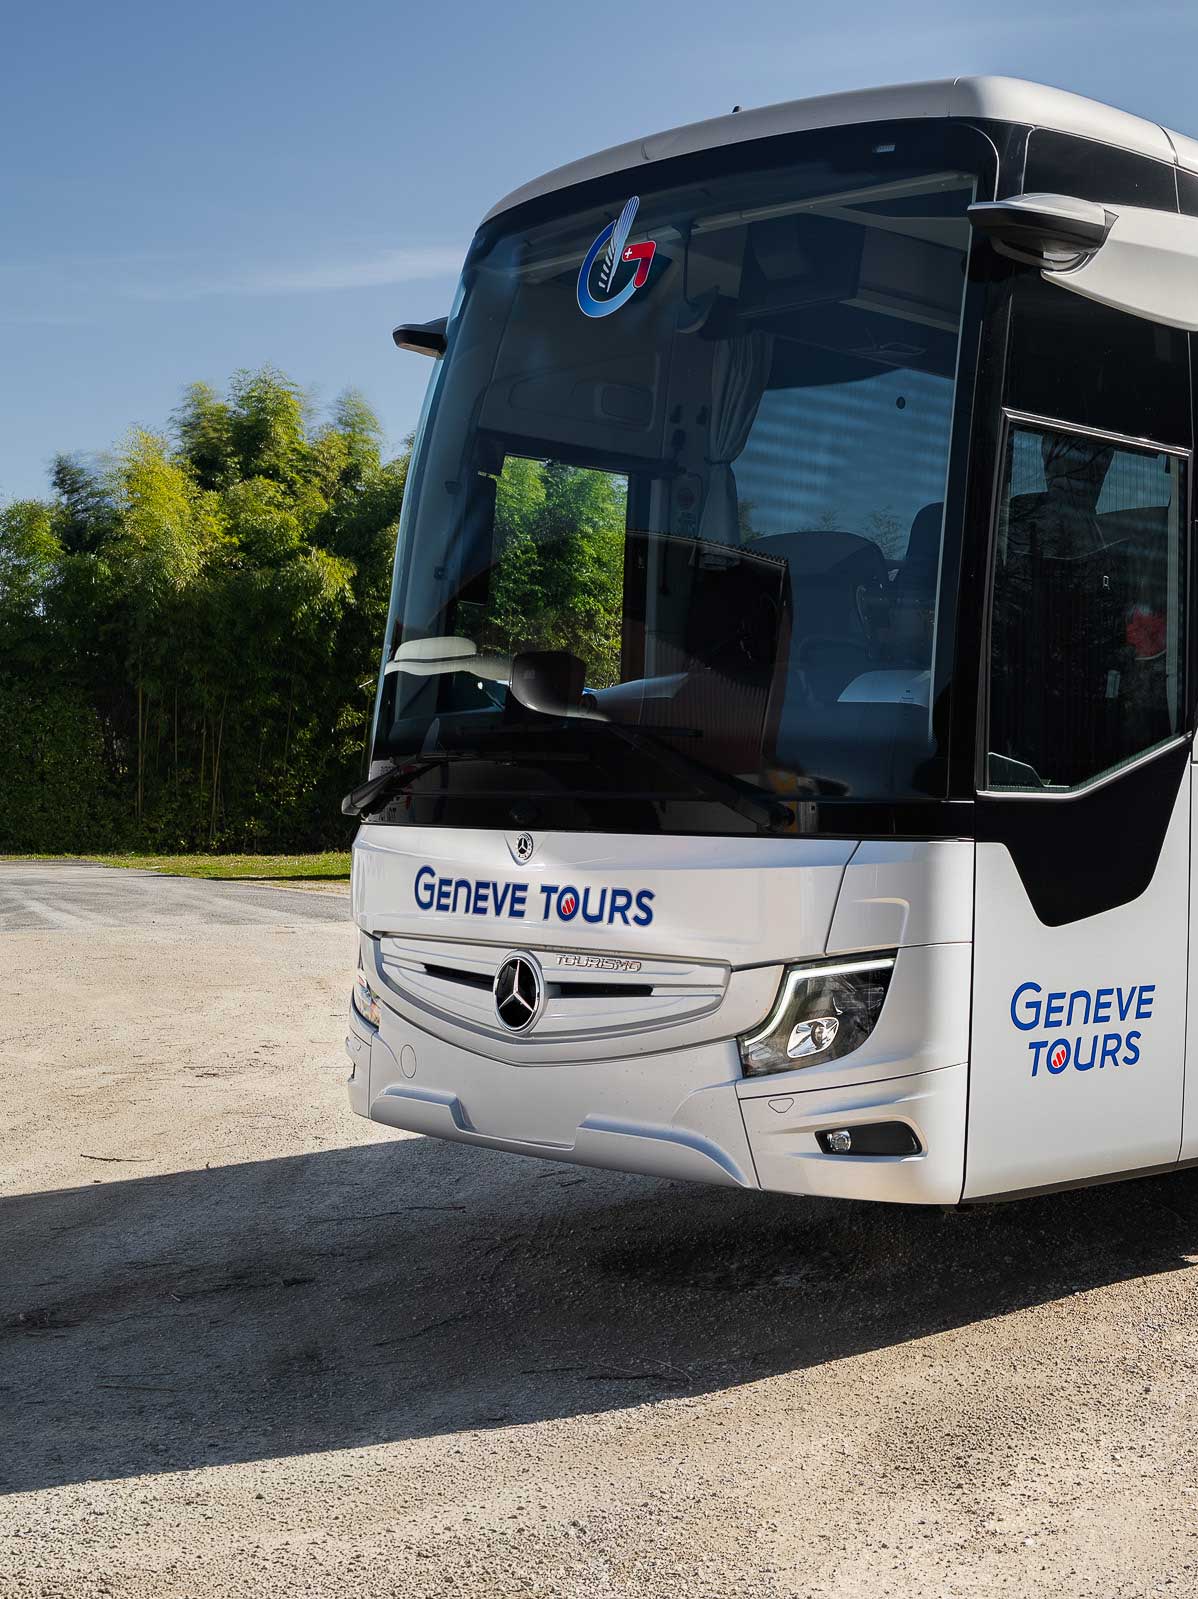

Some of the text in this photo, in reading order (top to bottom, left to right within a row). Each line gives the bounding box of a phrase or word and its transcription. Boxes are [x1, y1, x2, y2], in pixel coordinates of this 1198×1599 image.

[414, 865, 656, 927] GENEVE TOURS
[555, 953, 642, 972] TOURISMO
[1010, 981, 1156, 1031] GENEVE
[1028, 1030, 1142, 1077] TOURS
